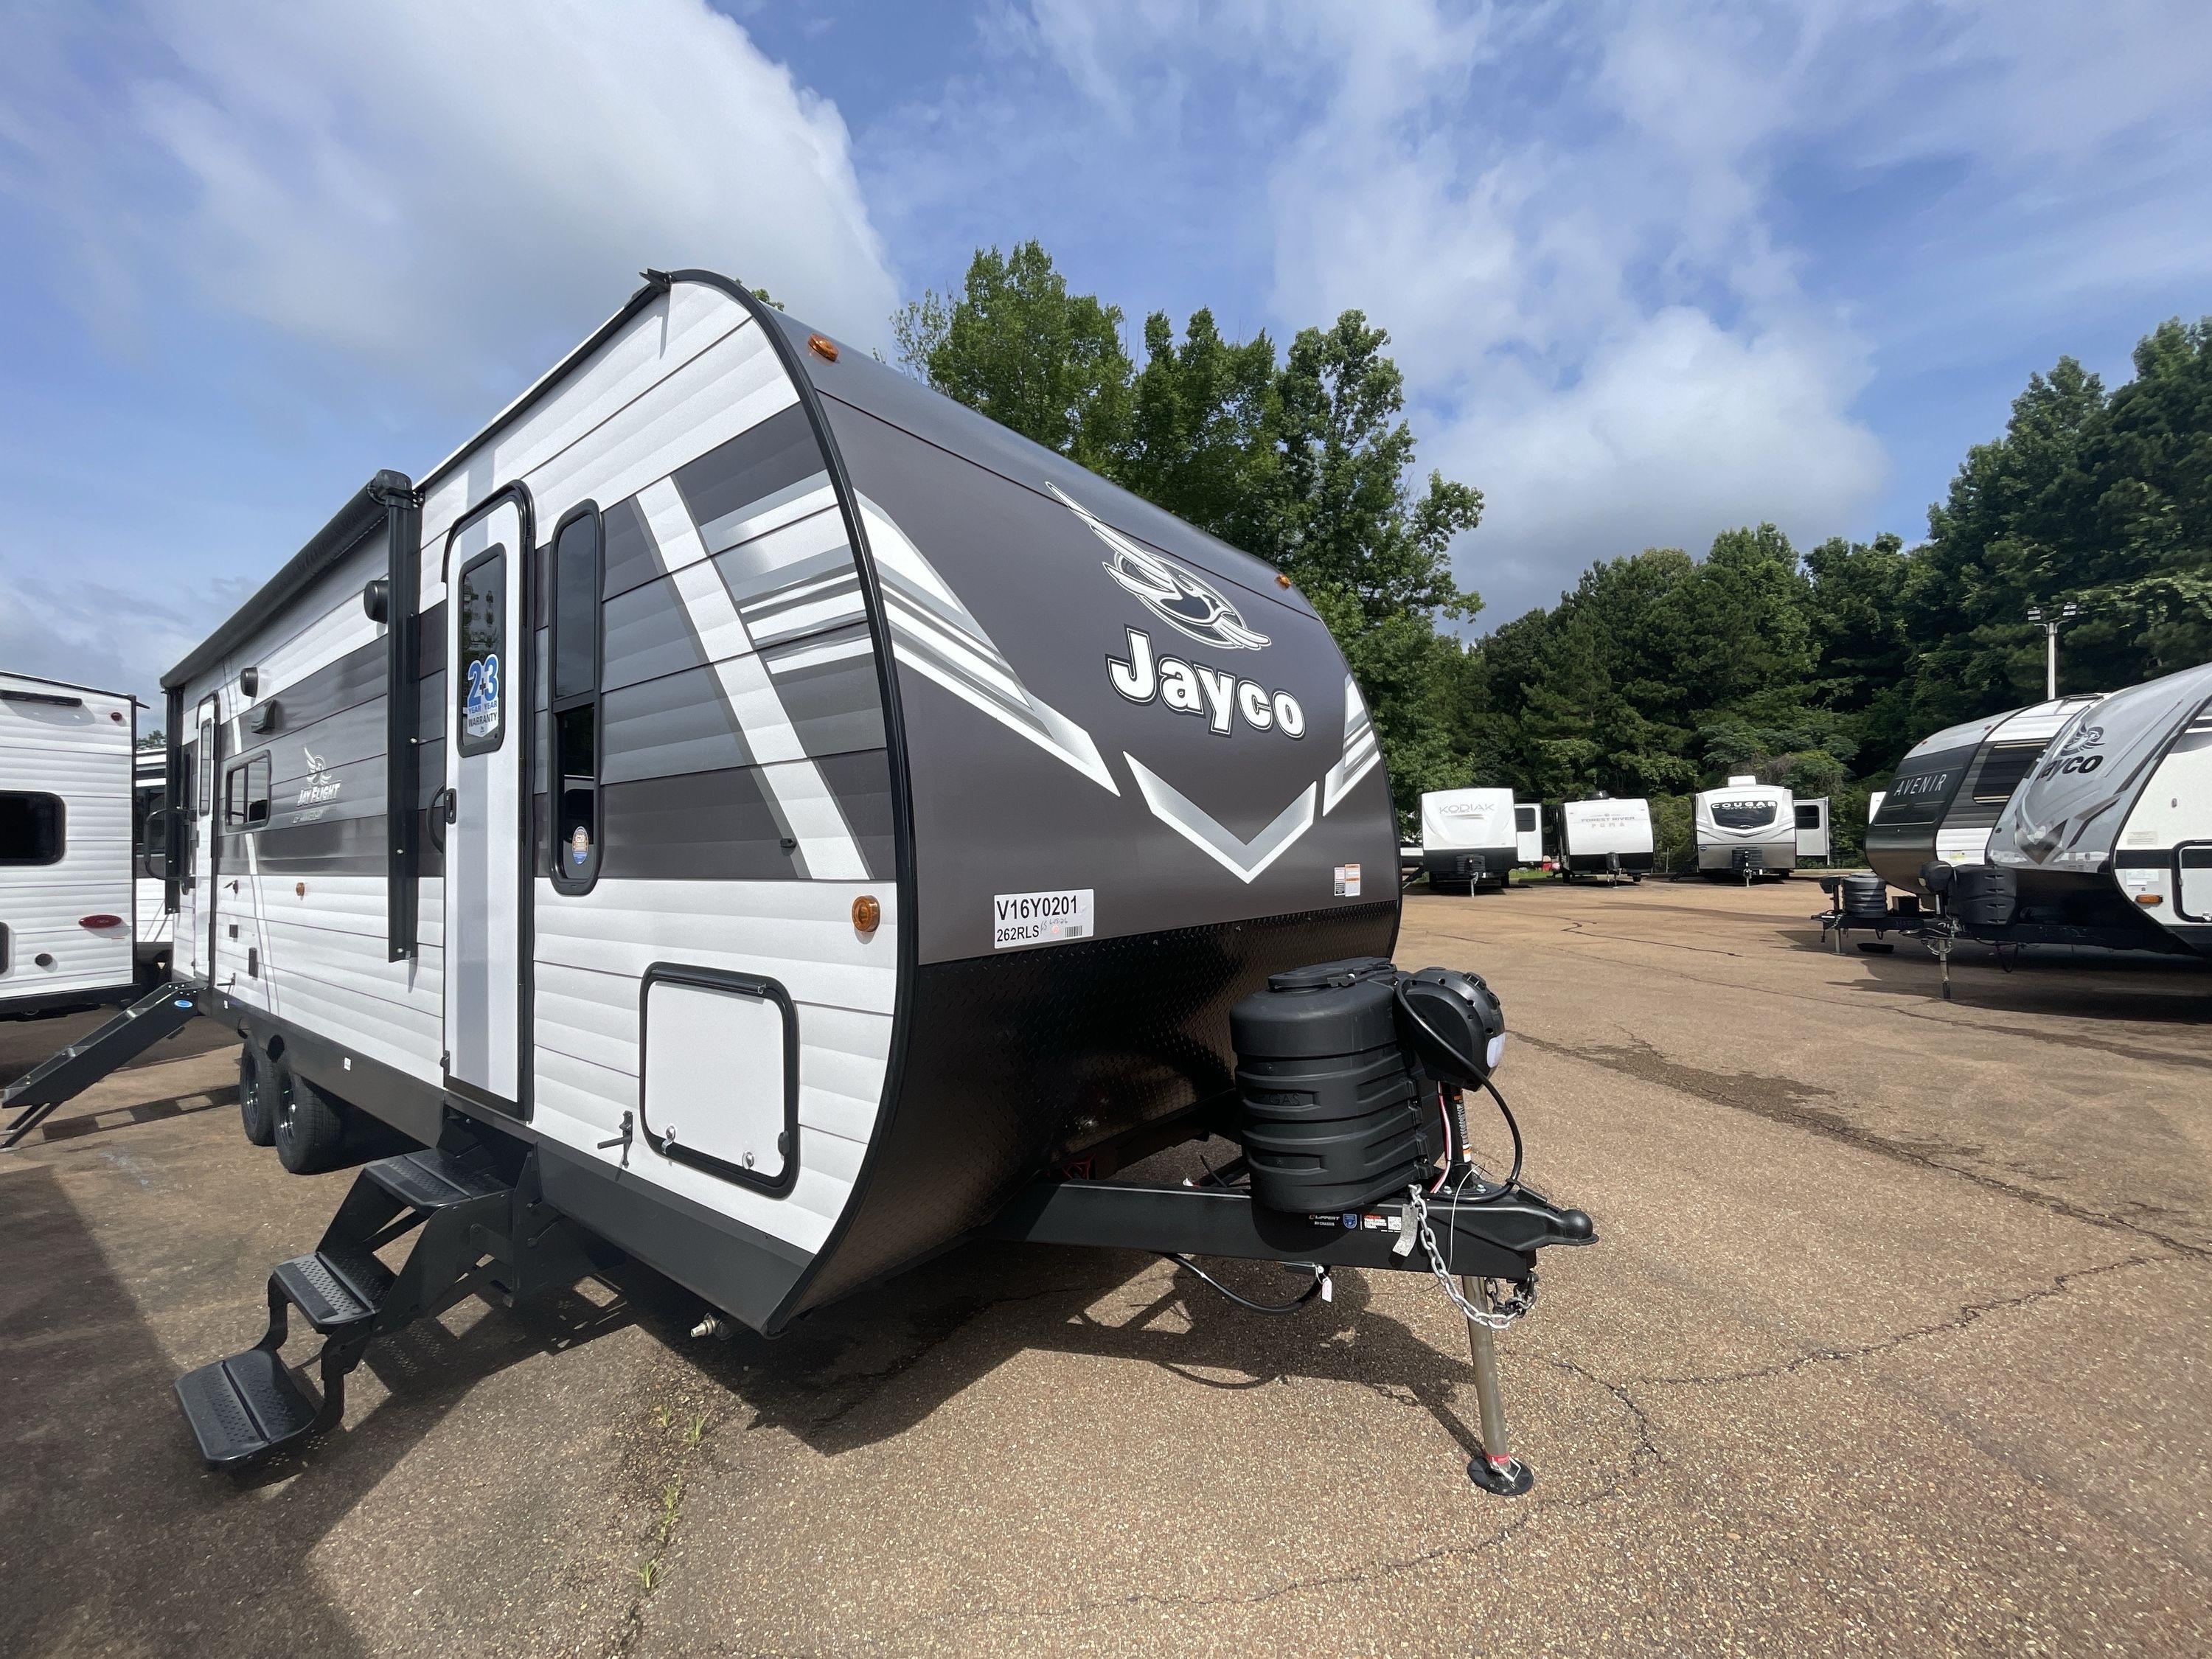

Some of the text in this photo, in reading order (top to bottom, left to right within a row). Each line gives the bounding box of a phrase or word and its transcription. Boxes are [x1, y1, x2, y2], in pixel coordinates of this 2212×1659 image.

[1105, 625, 1306, 740] Jayco
[469, 700, 497, 714] YEAR YEAR
[468, 712, 498, 727] WARRANTY
[311, 783, 341, 803] FLIGHT
[1893, 773, 1947, 796] AVENIR
[1439, 804, 1495, 814] KODIAK
[1711, 801, 1776, 809] COUGAR
[996, 895, 1077, 920] V16Y0201
[997, 925, 1040, 942] 262RLS
